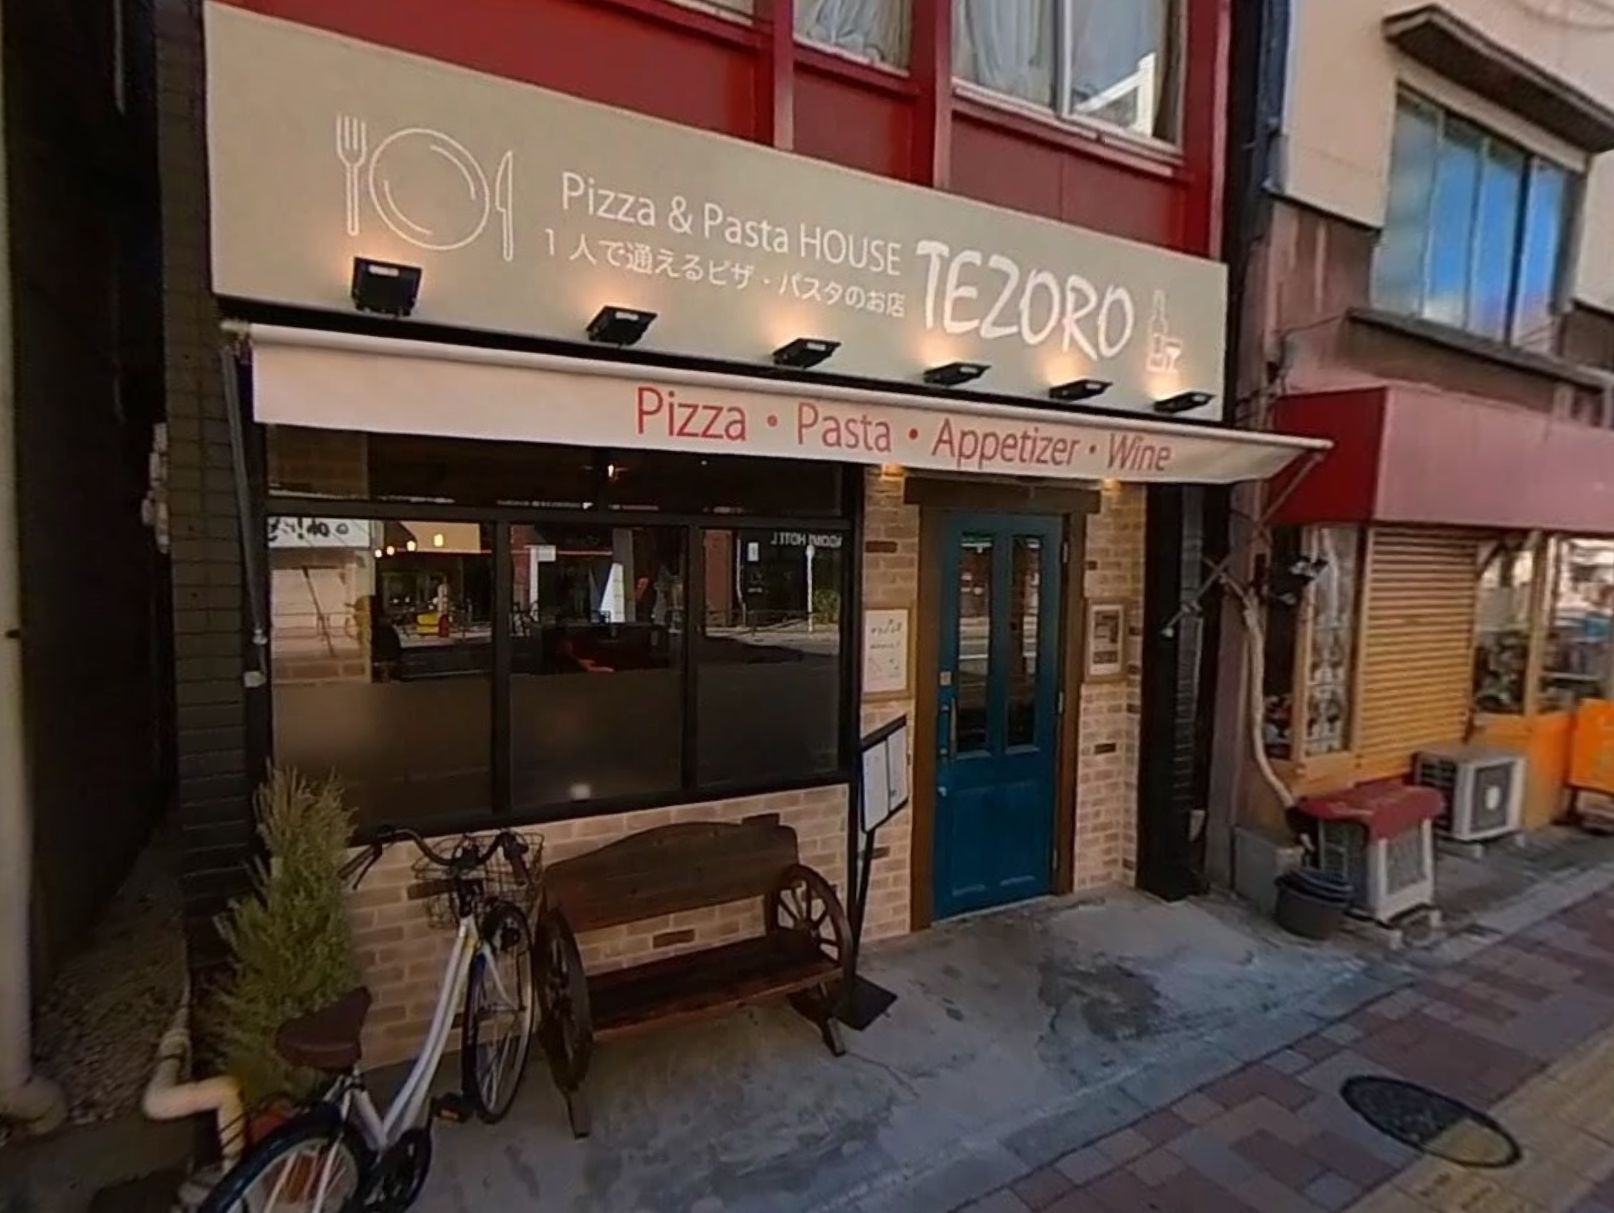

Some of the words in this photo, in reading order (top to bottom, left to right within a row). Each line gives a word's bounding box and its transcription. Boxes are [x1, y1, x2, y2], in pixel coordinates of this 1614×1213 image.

[561, 172, 656, 227] Pizza
[667, 195, 694, 235] &
[703, 203, 790, 256] Pasta
[799, 223, 903, 276] HOUSE
[916, 239, 1135, 361] TEZORO
[637, 386, 747, 442] Pizza
[797, 401, 892, 453] Pasta
[931, 416, 1081, 469] Appetizer
[1107, 432, 1172, 472] Wine
